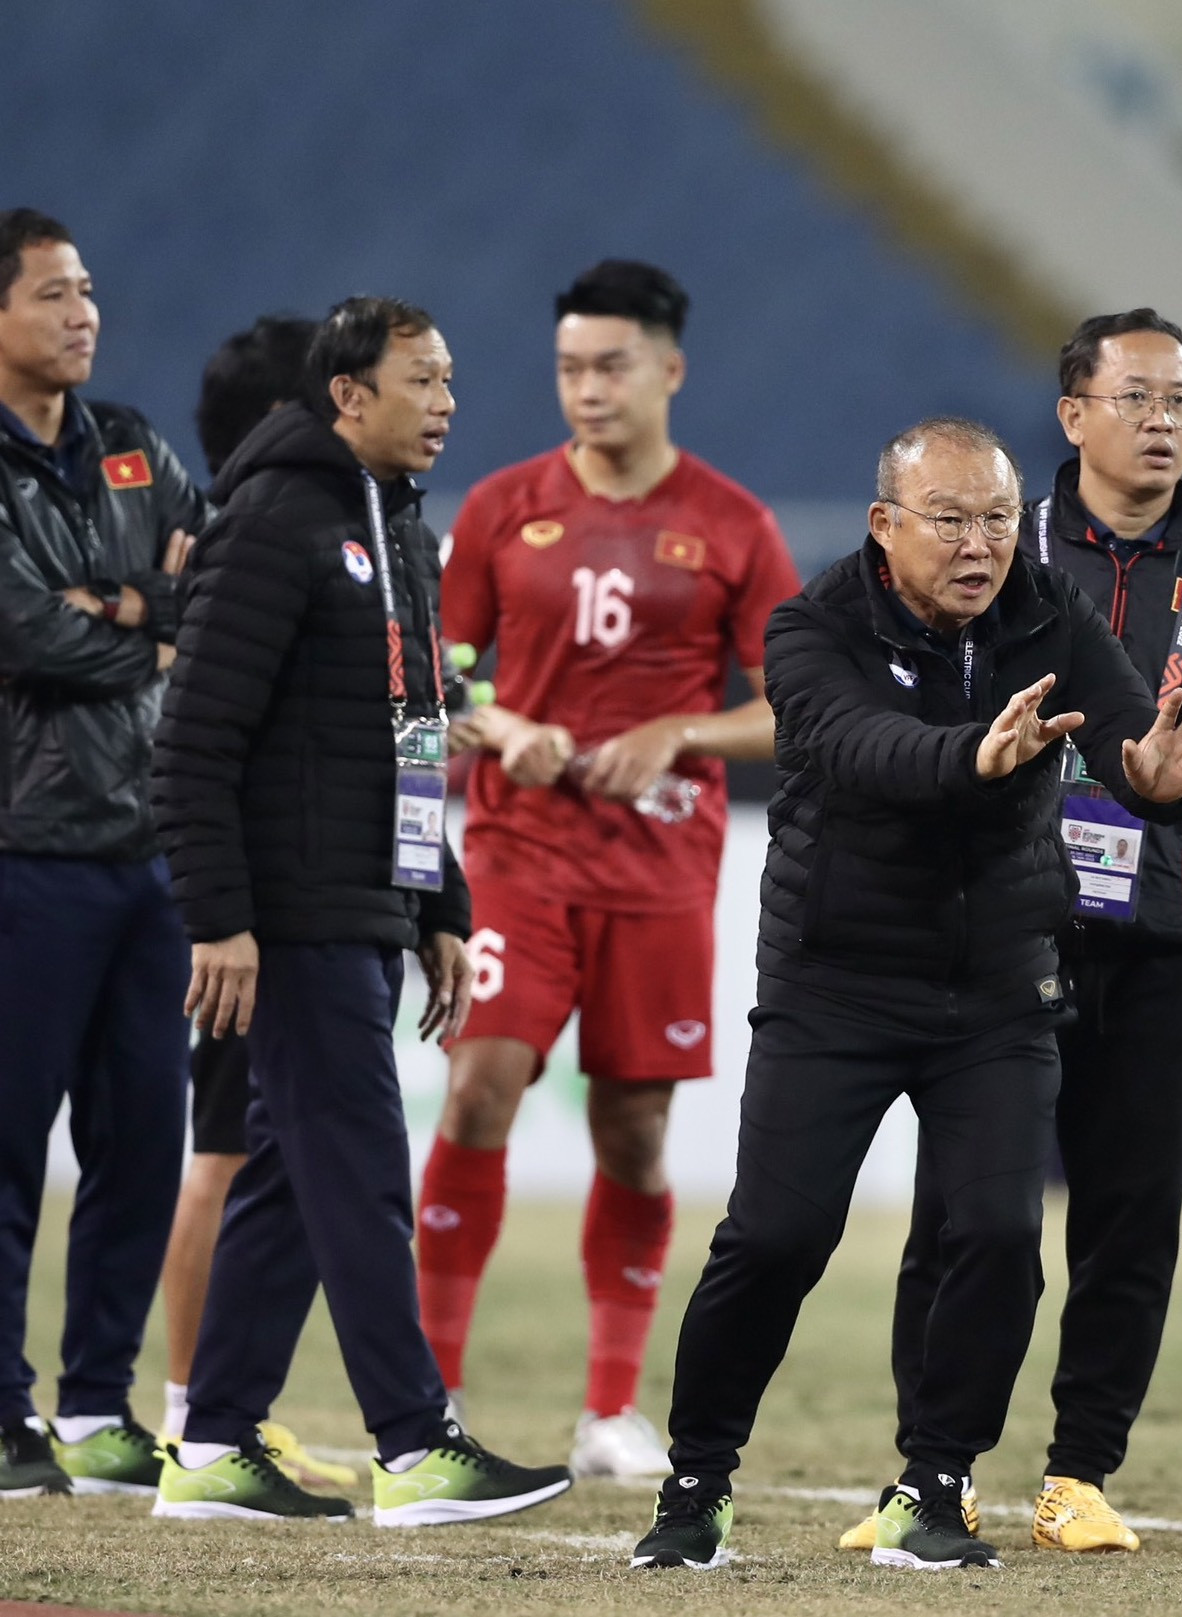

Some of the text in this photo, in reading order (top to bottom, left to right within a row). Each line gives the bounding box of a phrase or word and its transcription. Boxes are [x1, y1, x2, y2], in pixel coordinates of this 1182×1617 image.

[571, 566, 635, 648] 16
[1080, 899, 1105, 909] TEAM
[464, 926, 506, 1004] 6
